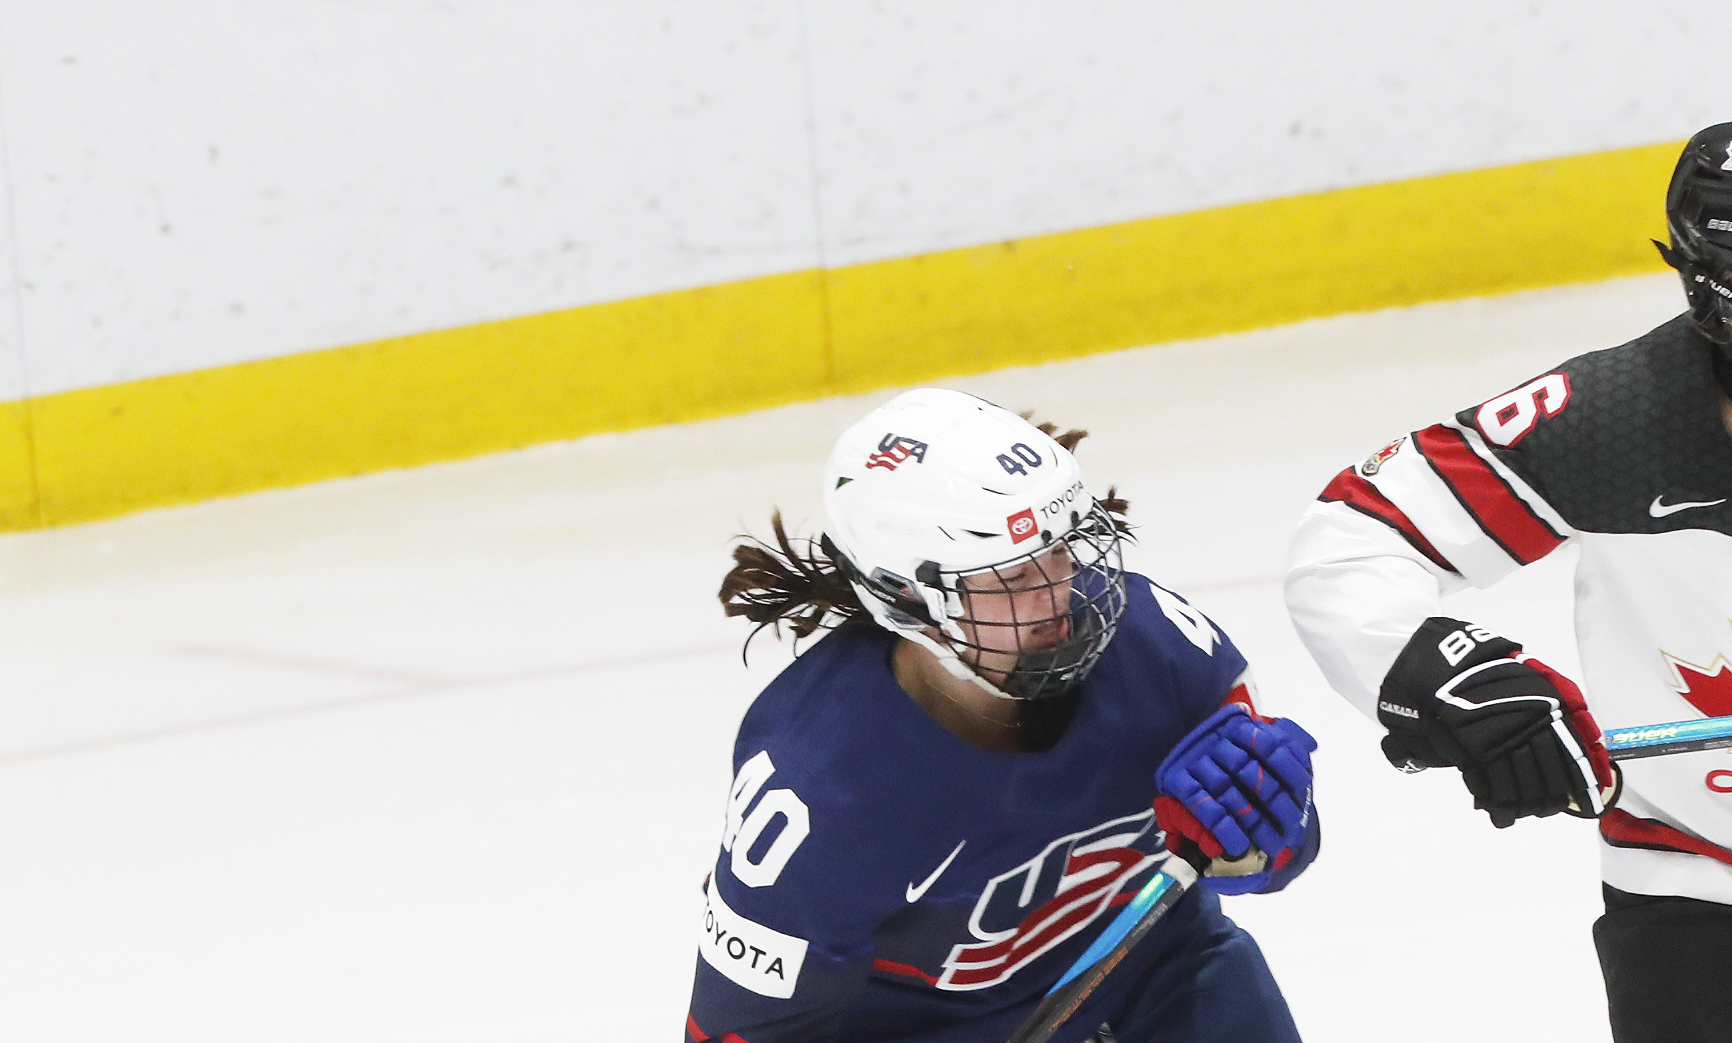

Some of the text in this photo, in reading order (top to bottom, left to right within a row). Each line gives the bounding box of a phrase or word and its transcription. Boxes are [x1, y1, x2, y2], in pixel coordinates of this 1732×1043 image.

[996, 442, 1042, 477] 40
[1040, 481, 1085, 521] TOYOTA
[721, 749, 811, 888] 40
[704, 910, 785, 981] OYOTA
